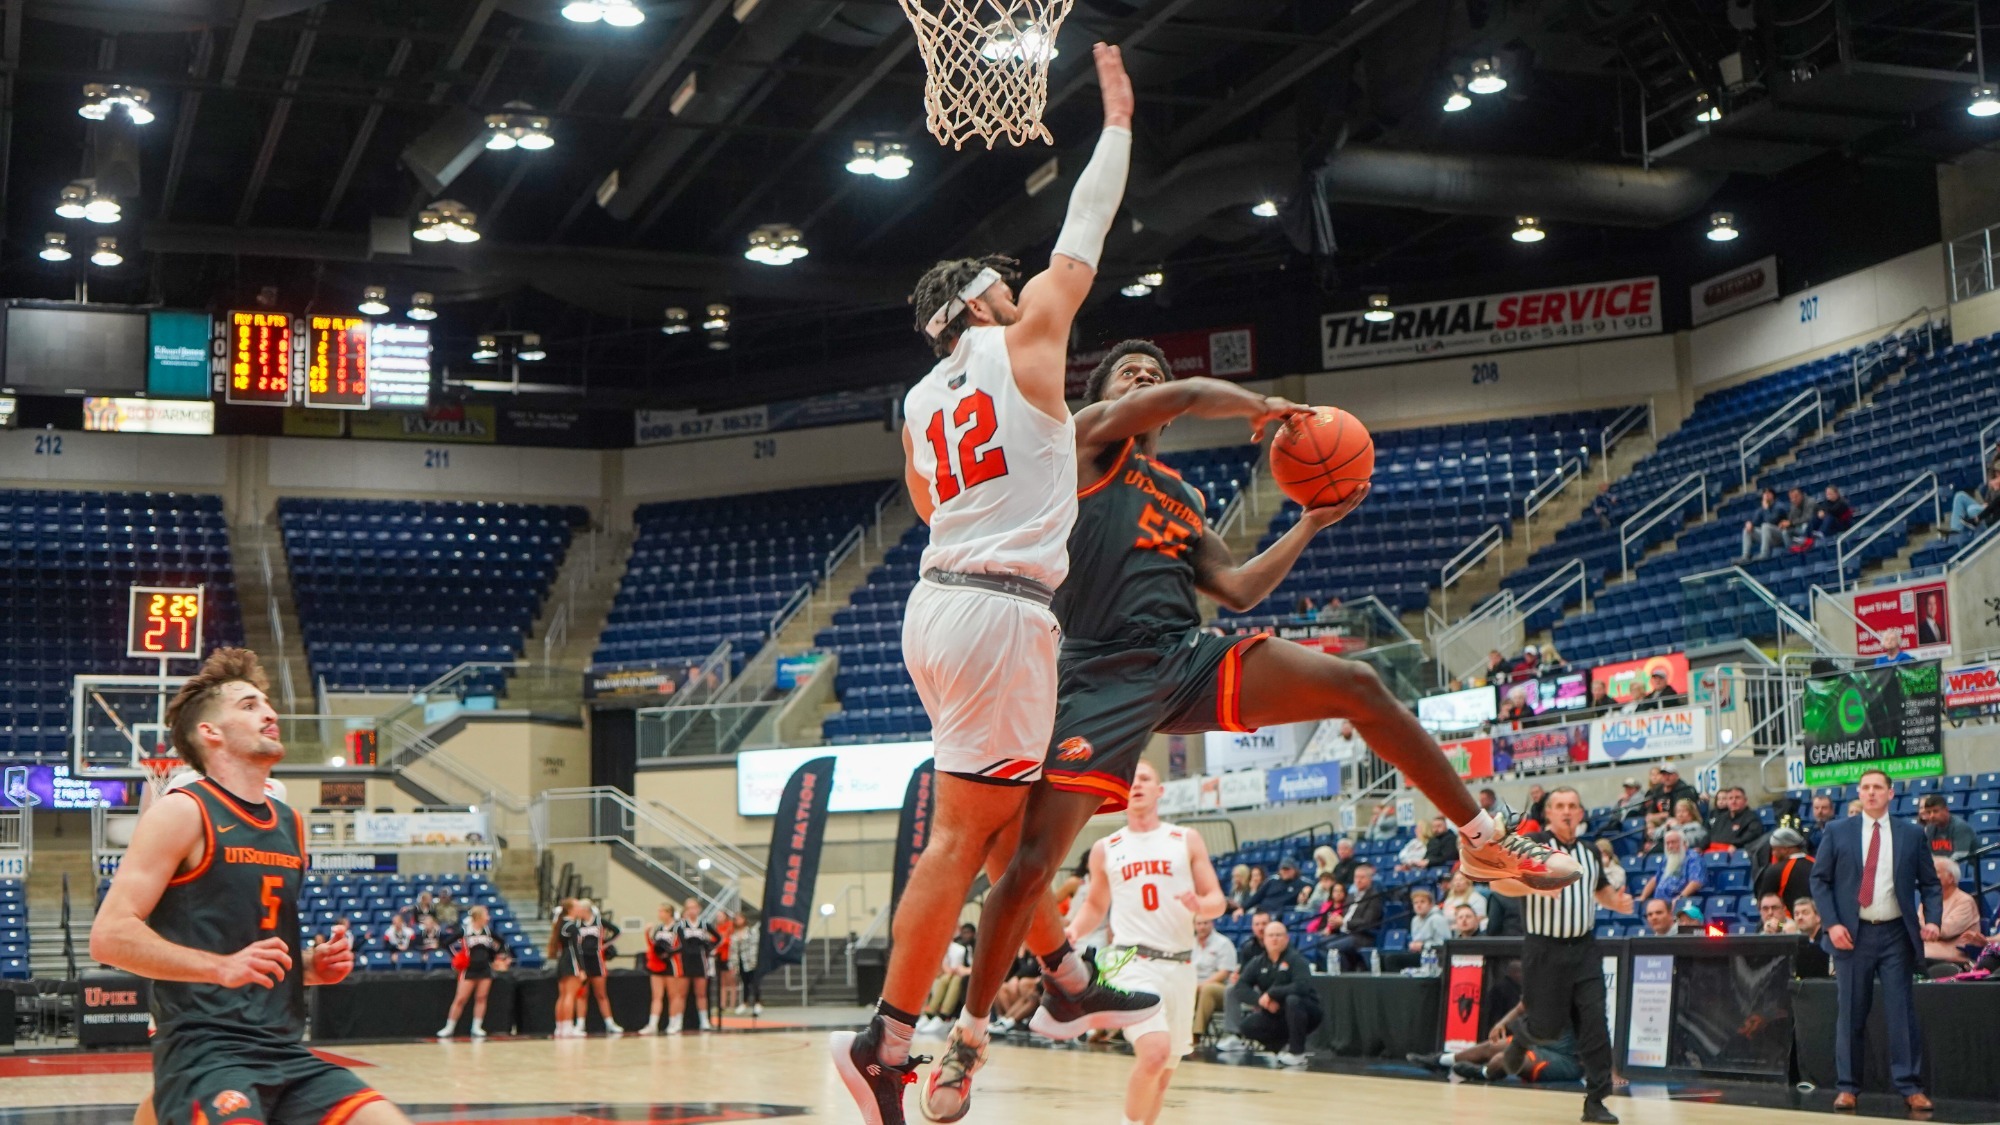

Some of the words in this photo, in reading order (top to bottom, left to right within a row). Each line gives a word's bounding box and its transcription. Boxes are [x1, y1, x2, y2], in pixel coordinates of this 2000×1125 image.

[1800, 296, 1818, 323] 207
[212, 320, 227, 393] HOME
[292, 318, 305, 402] GUEST
[1472, 363, 1499, 385] 208
[35, 436, 62, 455] 212
[424, 450, 449, 468] 211
[926, 388, 1009, 505] 12
[1135, 503, 1191, 559] 55
[145, 616, 187, 651] 27
[1949, 670, 1997, 692] WPRG
[1601, 712, 1693, 739] MOUNTAIN
[1240, 736, 1276, 749] ATM
[1809, 739, 1876, 765] GEARHEART
[1880, 737, 1898, 756] TV
[792, 773, 817, 849] NATION
[912, 772, 931, 848] NATION
[781, 854, 803, 908] BEAR
[1122, 860, 1173, 881] UPIKE
[260, 875, 284, 930] 5
[1142, 883, 1159, 911] 0
[84, 1013, 114, 1024] PROTECT
[115, 1013, 128, 1023] THIS
[128, 1012, 149, 1023] HOUS
